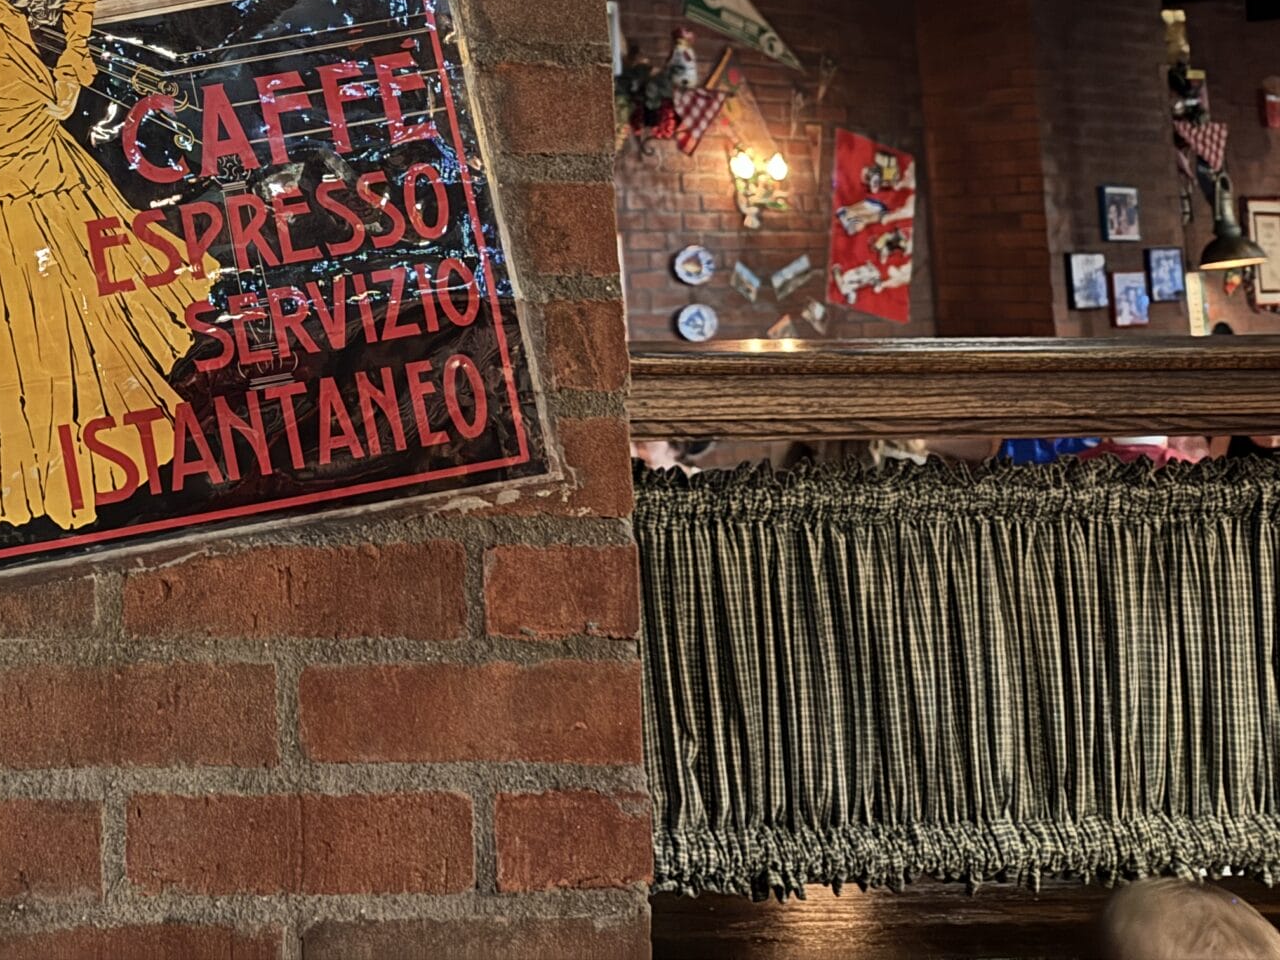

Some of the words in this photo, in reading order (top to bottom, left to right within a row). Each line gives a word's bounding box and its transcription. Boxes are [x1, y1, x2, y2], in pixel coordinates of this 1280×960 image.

[84, 162, 450, 297] ESPRESSO
[185, 257, 481, 374] SERVIZIO
[57, 354, 489, 512] ISTANTANEO
